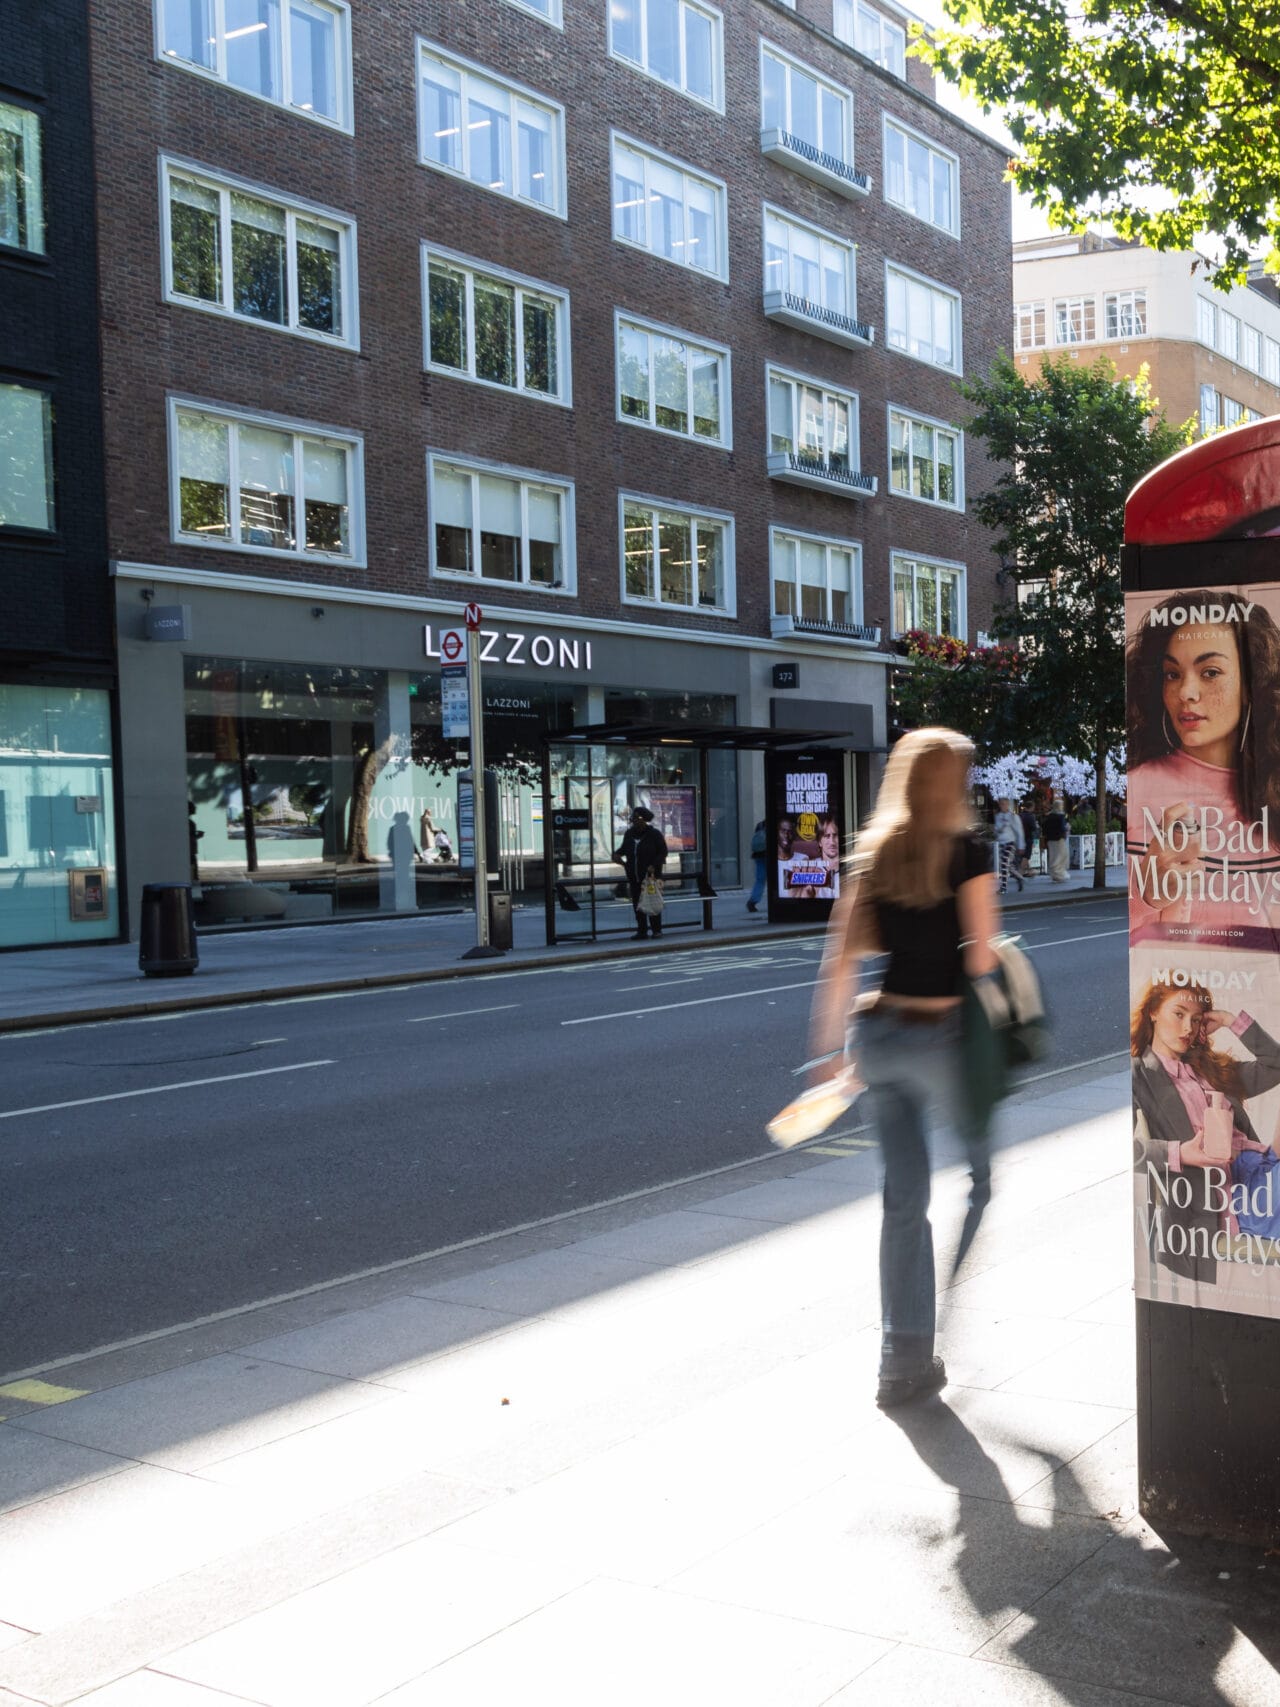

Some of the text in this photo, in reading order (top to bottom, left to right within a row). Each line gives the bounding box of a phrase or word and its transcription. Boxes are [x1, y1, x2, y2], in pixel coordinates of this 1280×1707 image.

[467, 607, 478, 624] N
[1150, 603, 1255, 628] MONDAY
[1178, 630, 1232, 641] HAIRCARE
[424, 624, 592, 670] LZZONI
[779, 672, 793, 682] 172
[786, 772, 828, 791] BOOKED
[786, 790, 828, 804] DATE NIGHT
[1141, 805, 1270, 854] No Bad
[792, 873, 825, 884] SNICKERS
[1151, 967, 1257, 991] MONDAY
[1146, 1160, 1275, 1218] No Bad
